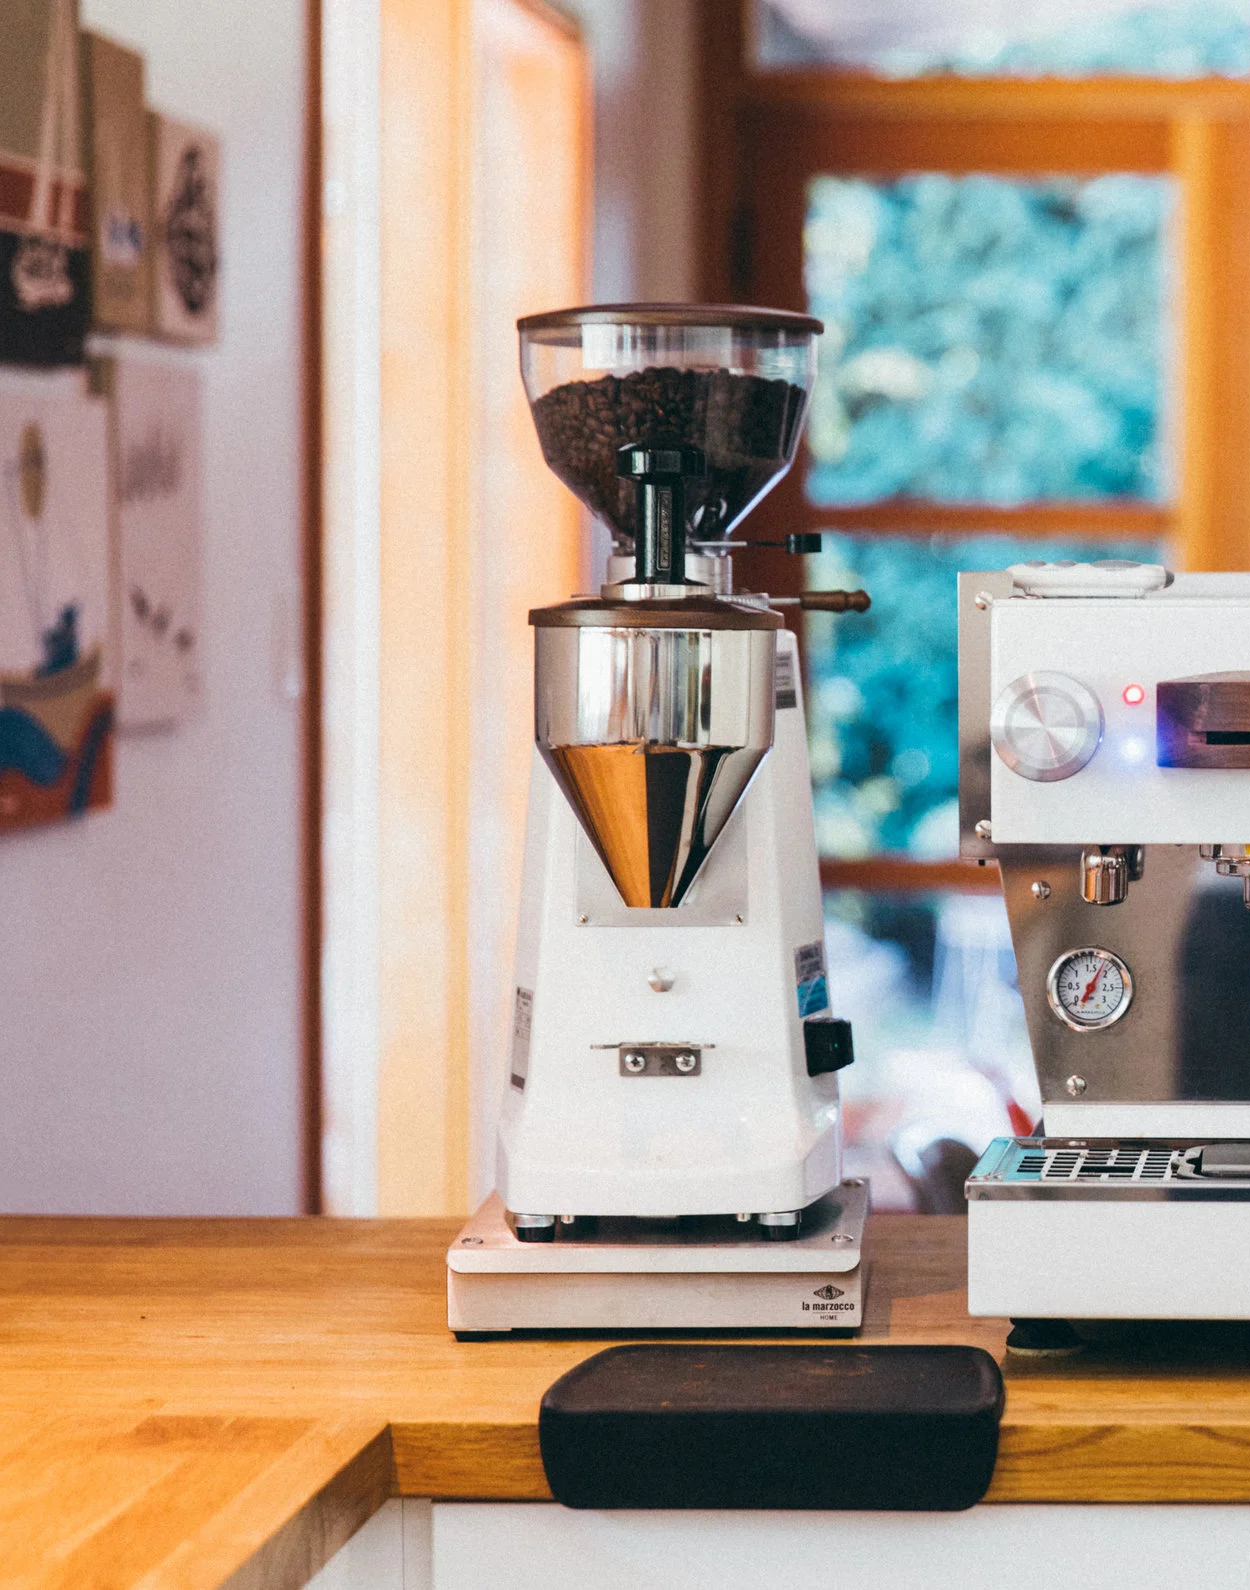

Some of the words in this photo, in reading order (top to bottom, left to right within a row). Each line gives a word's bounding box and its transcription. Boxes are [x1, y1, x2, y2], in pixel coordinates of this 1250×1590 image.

[1086, 964, 1097, 973] 1,5
[1068, 983, 1080, 991] 0,5
[802, 1301, 810, 1310] la
